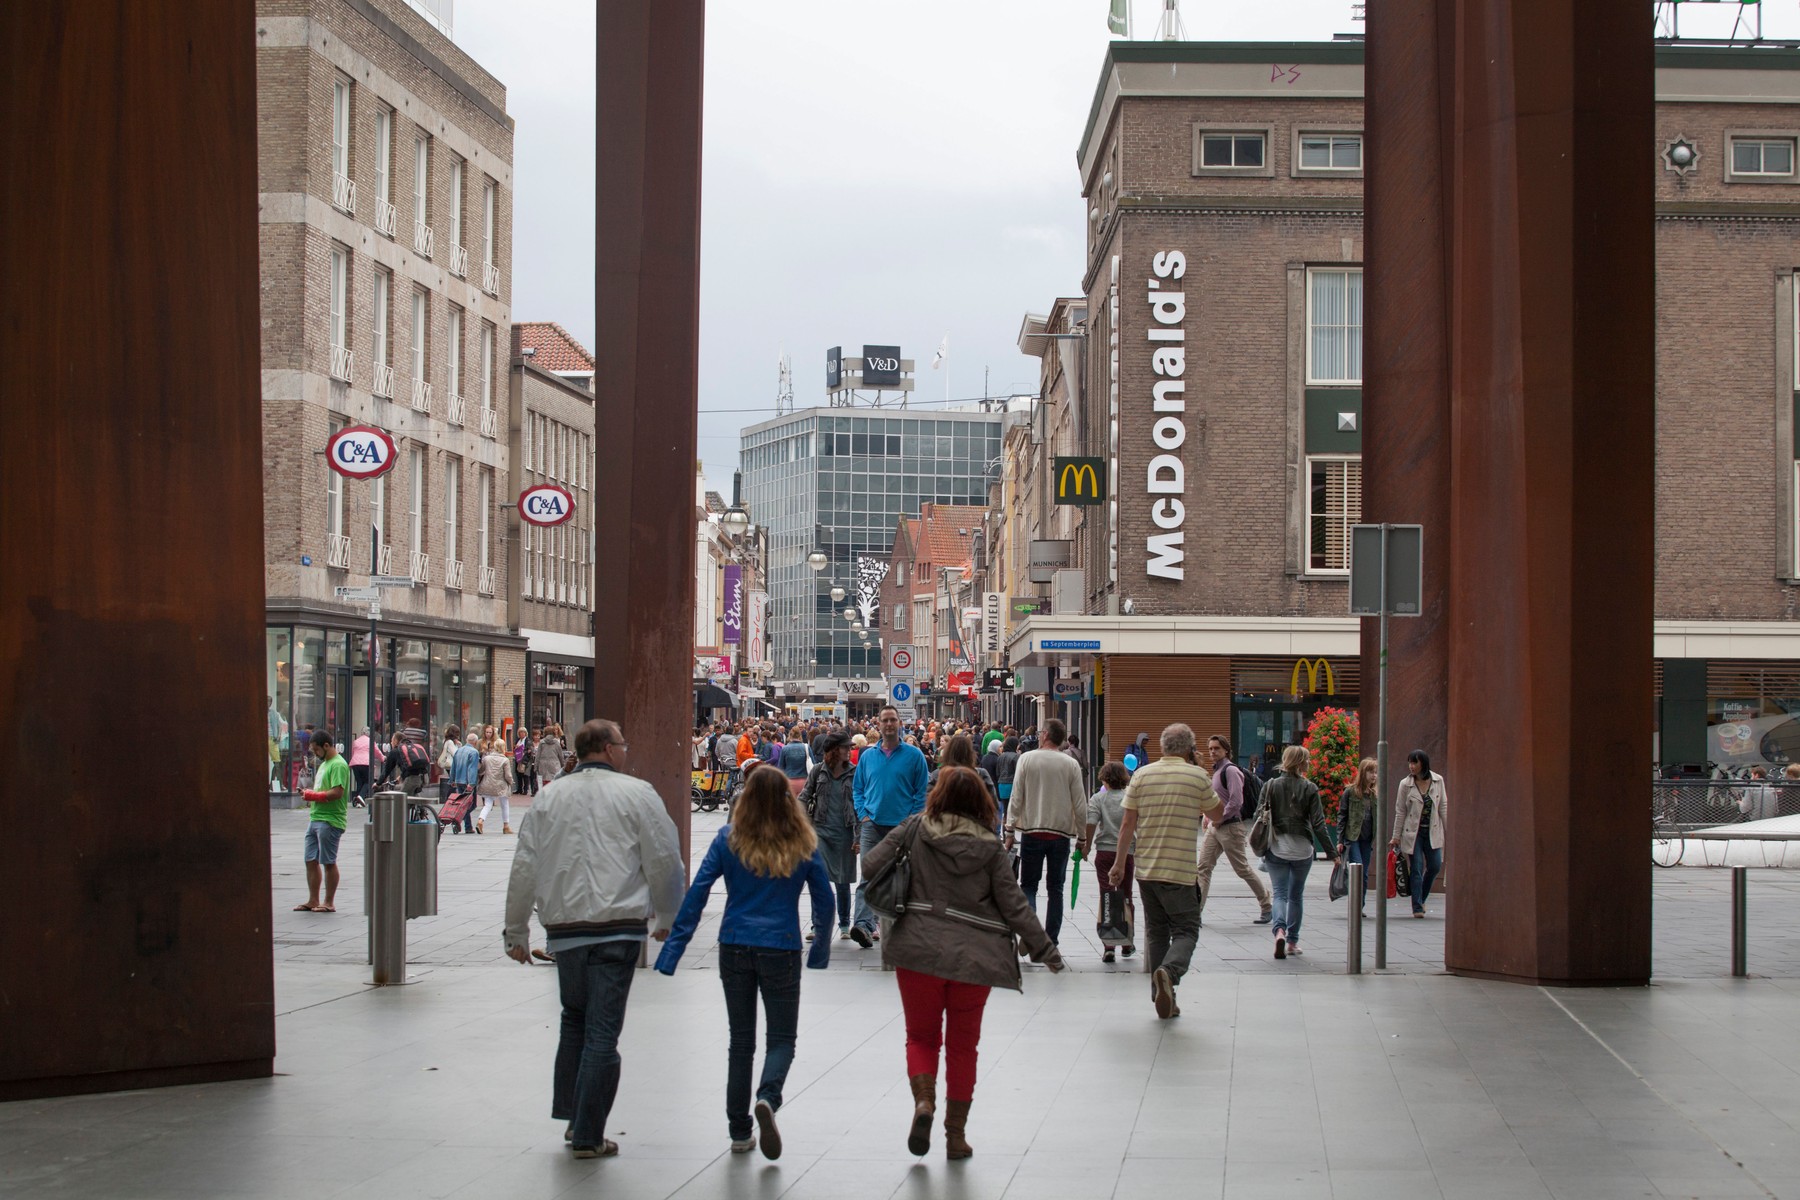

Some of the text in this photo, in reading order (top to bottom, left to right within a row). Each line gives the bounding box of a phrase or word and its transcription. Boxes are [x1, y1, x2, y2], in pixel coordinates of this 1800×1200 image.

[867, 357, 898, 371] V&D
[1147, 250, 1187, 581] McDonald's
[338, 440, 383, 464] C&A
[527, 496, 564, 515] C&A
[723, 578, 742, 630] Etam
[988, 594, 998, 651] MANFIELD
[1050, 641, 1099, 649] Septemberplein
[842, 681, 870, 693] V&D
[1056, 683, 1080, 694] etos
[1723, 702, 1743, 711] Koffie
